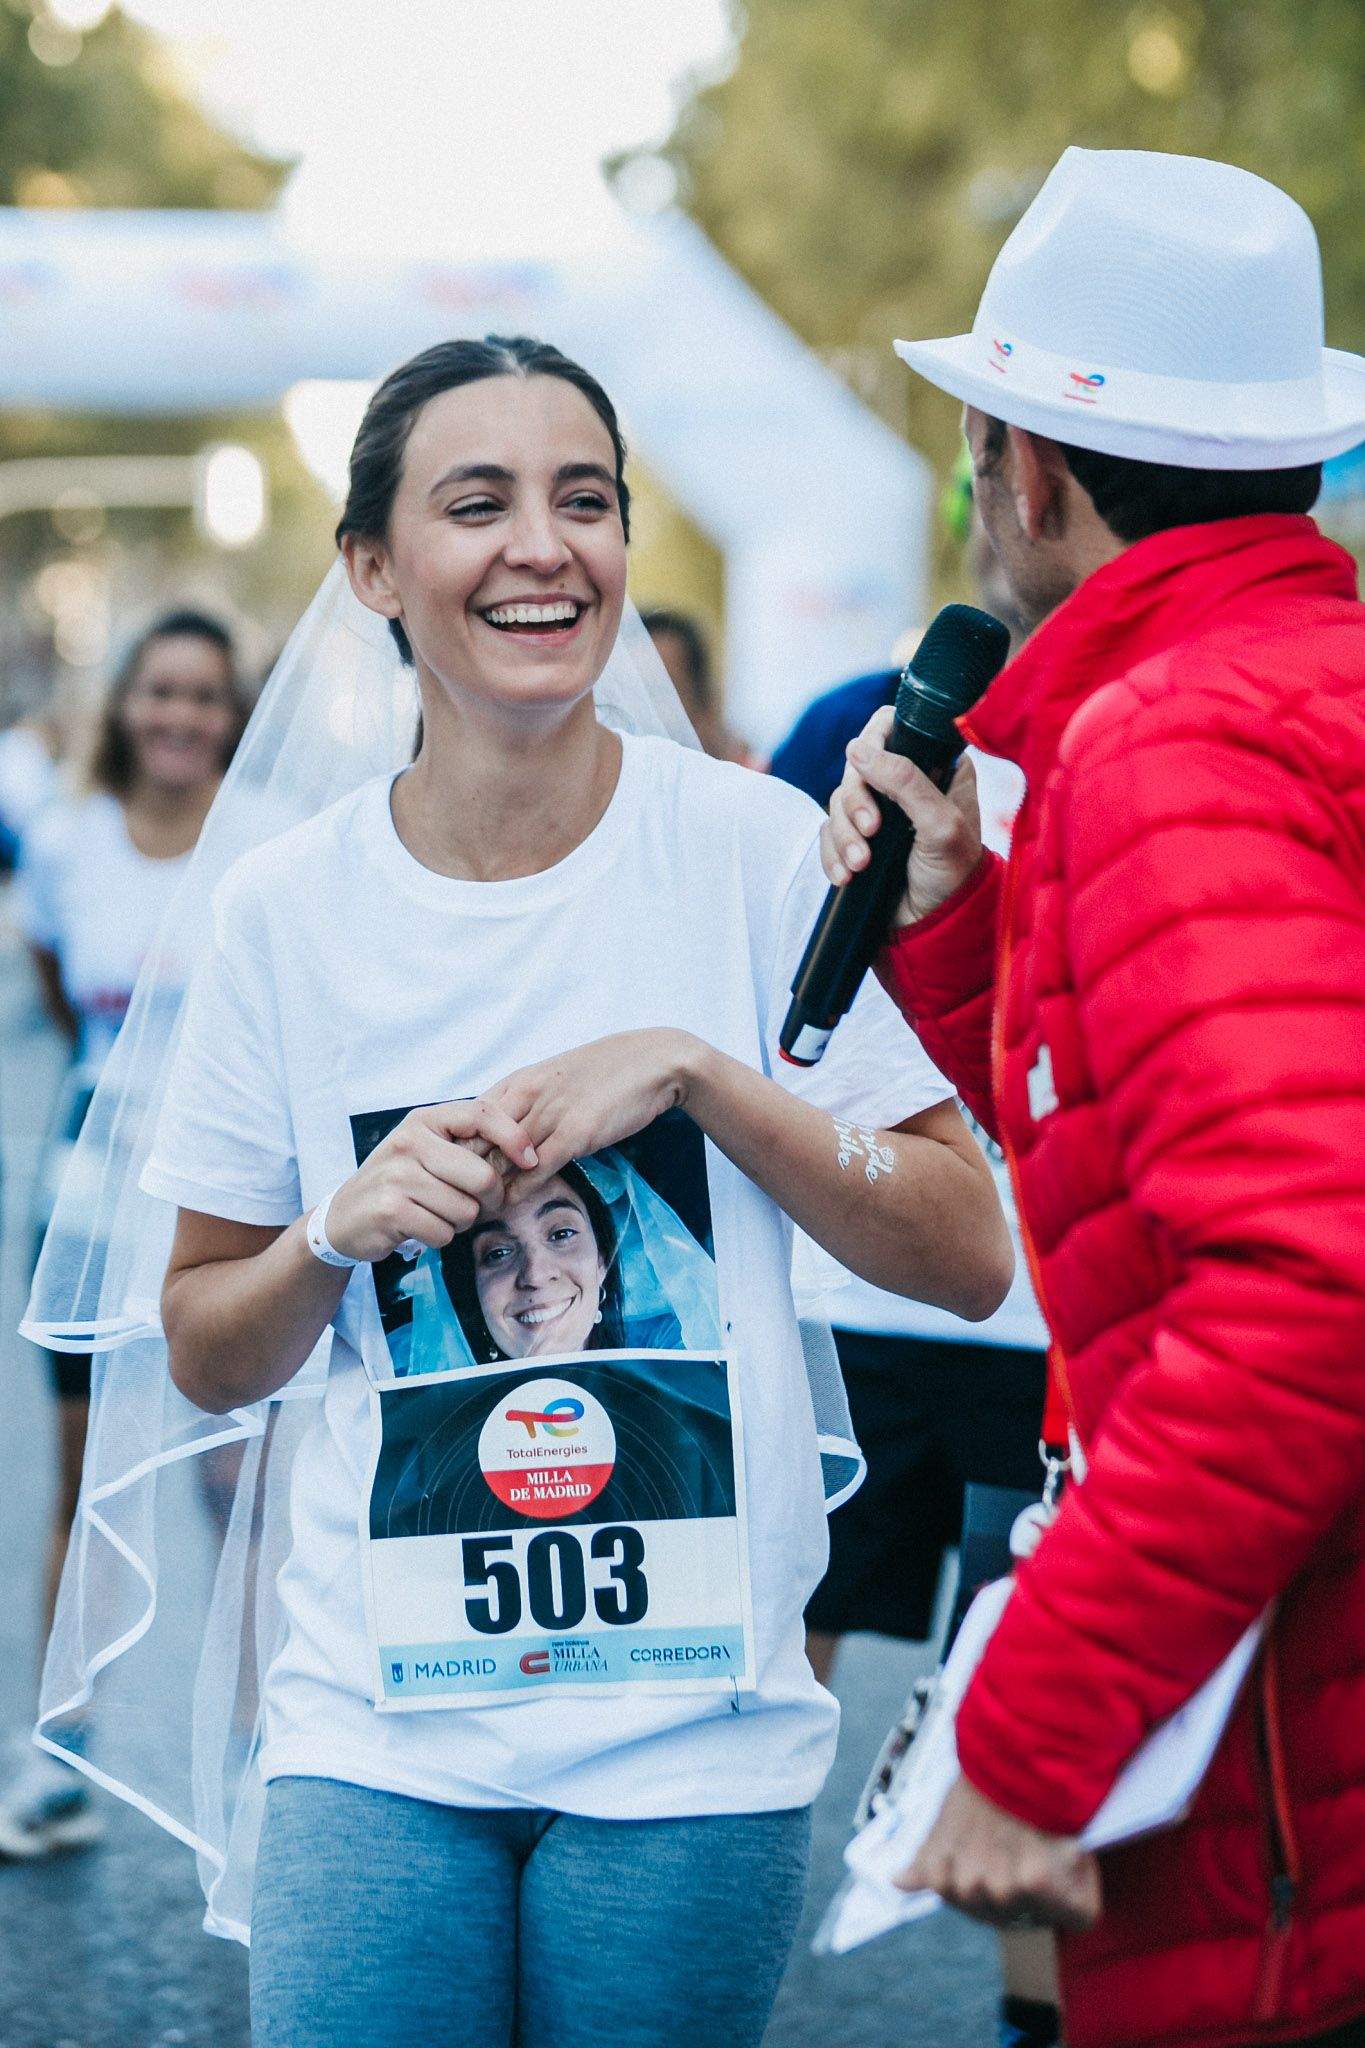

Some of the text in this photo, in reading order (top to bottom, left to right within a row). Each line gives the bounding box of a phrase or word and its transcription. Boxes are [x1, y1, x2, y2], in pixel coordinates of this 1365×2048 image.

[506, 1444, 588, 1459] TotalEnergies
[526, 1470, 574, 1485] MILLA
[510, 1483, 592, 1501] DE MADRID
[461, 1525, 649, 1635] 503
[553, 1646, 600, 1659] MILLA
[415, 1658, 497, 1679] MADRID
[554, 1659, 608, 1672] URBANA
